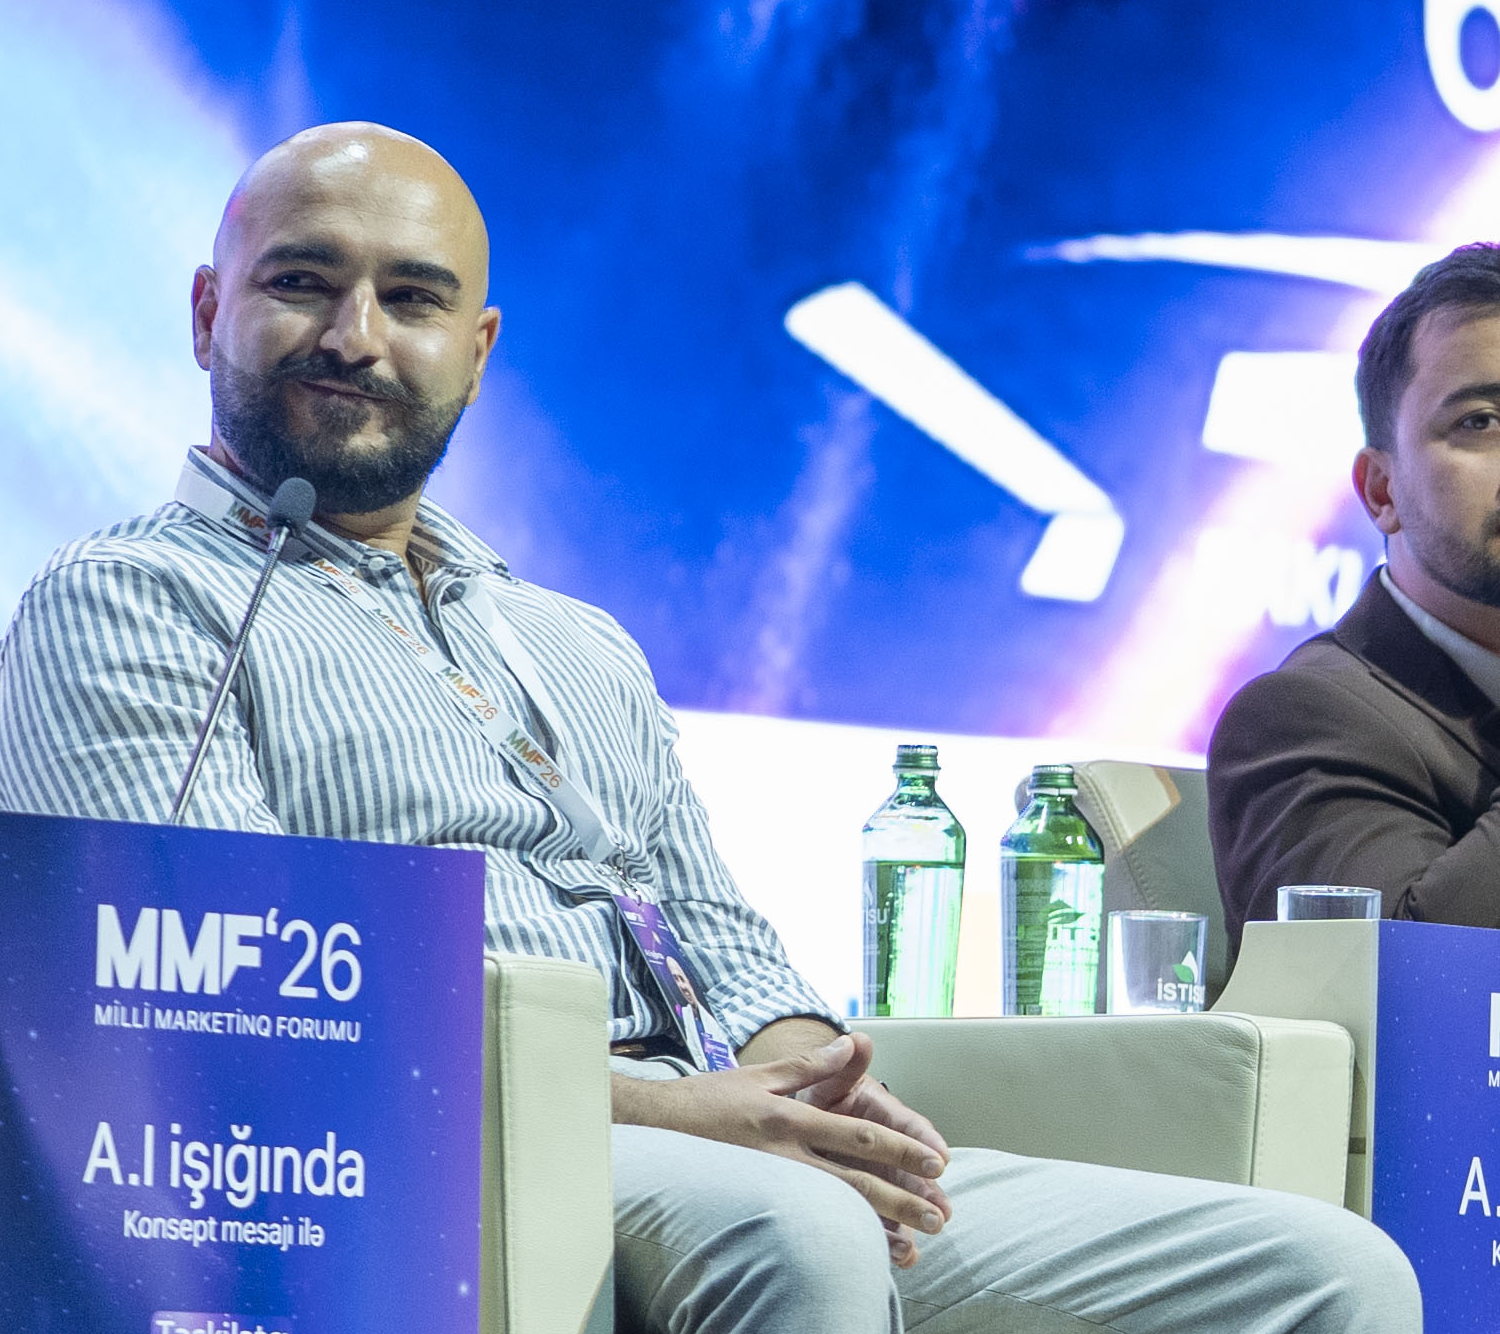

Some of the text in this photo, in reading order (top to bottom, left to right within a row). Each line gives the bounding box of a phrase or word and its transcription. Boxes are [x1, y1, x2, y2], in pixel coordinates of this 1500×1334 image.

[94, 999, 362, 1043] MİLLİ MARKETİNQ FORUMU
[82, 1121, 365, 1209] A.I işığında
[123, 1210, 325, 1252] Konsept mesajı ilə
